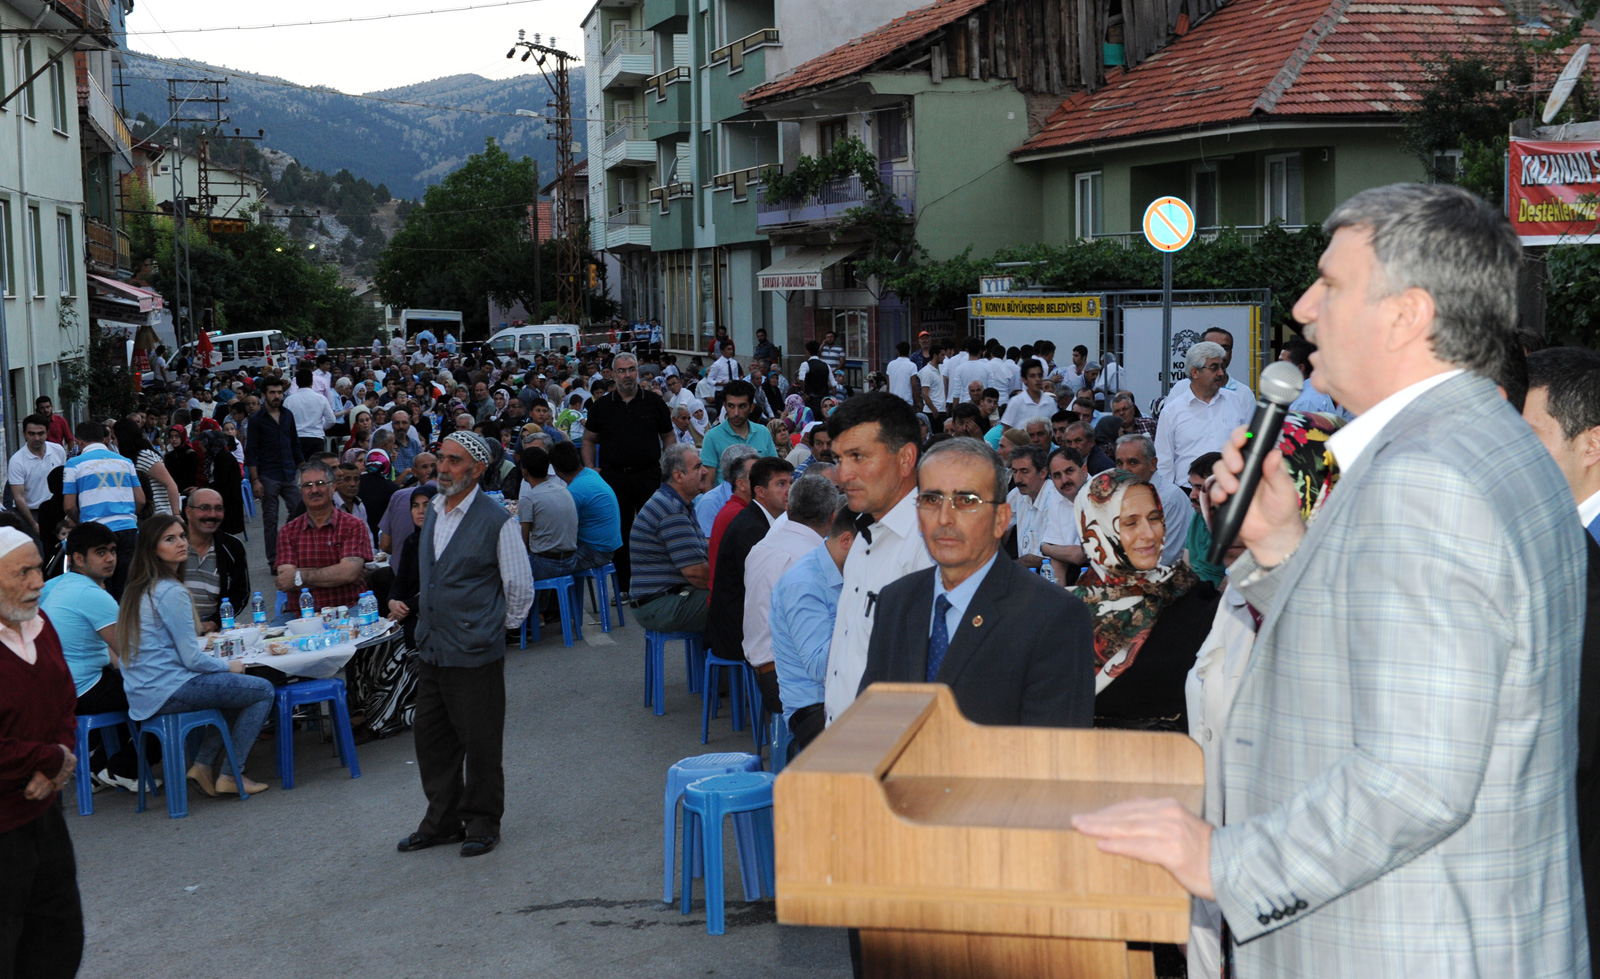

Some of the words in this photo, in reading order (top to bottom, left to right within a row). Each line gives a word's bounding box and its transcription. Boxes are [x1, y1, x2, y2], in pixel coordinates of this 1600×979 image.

[1520, 152, 1593, 186] KAZANAN
[985, 302, 1006, 313] KONYA
[1007, 300, 1045, 315] BÜYÜKŞEHİR
[1046, 301, 1083, 314] BELEDİYESİ
[95, 471, 126, 490] XV
